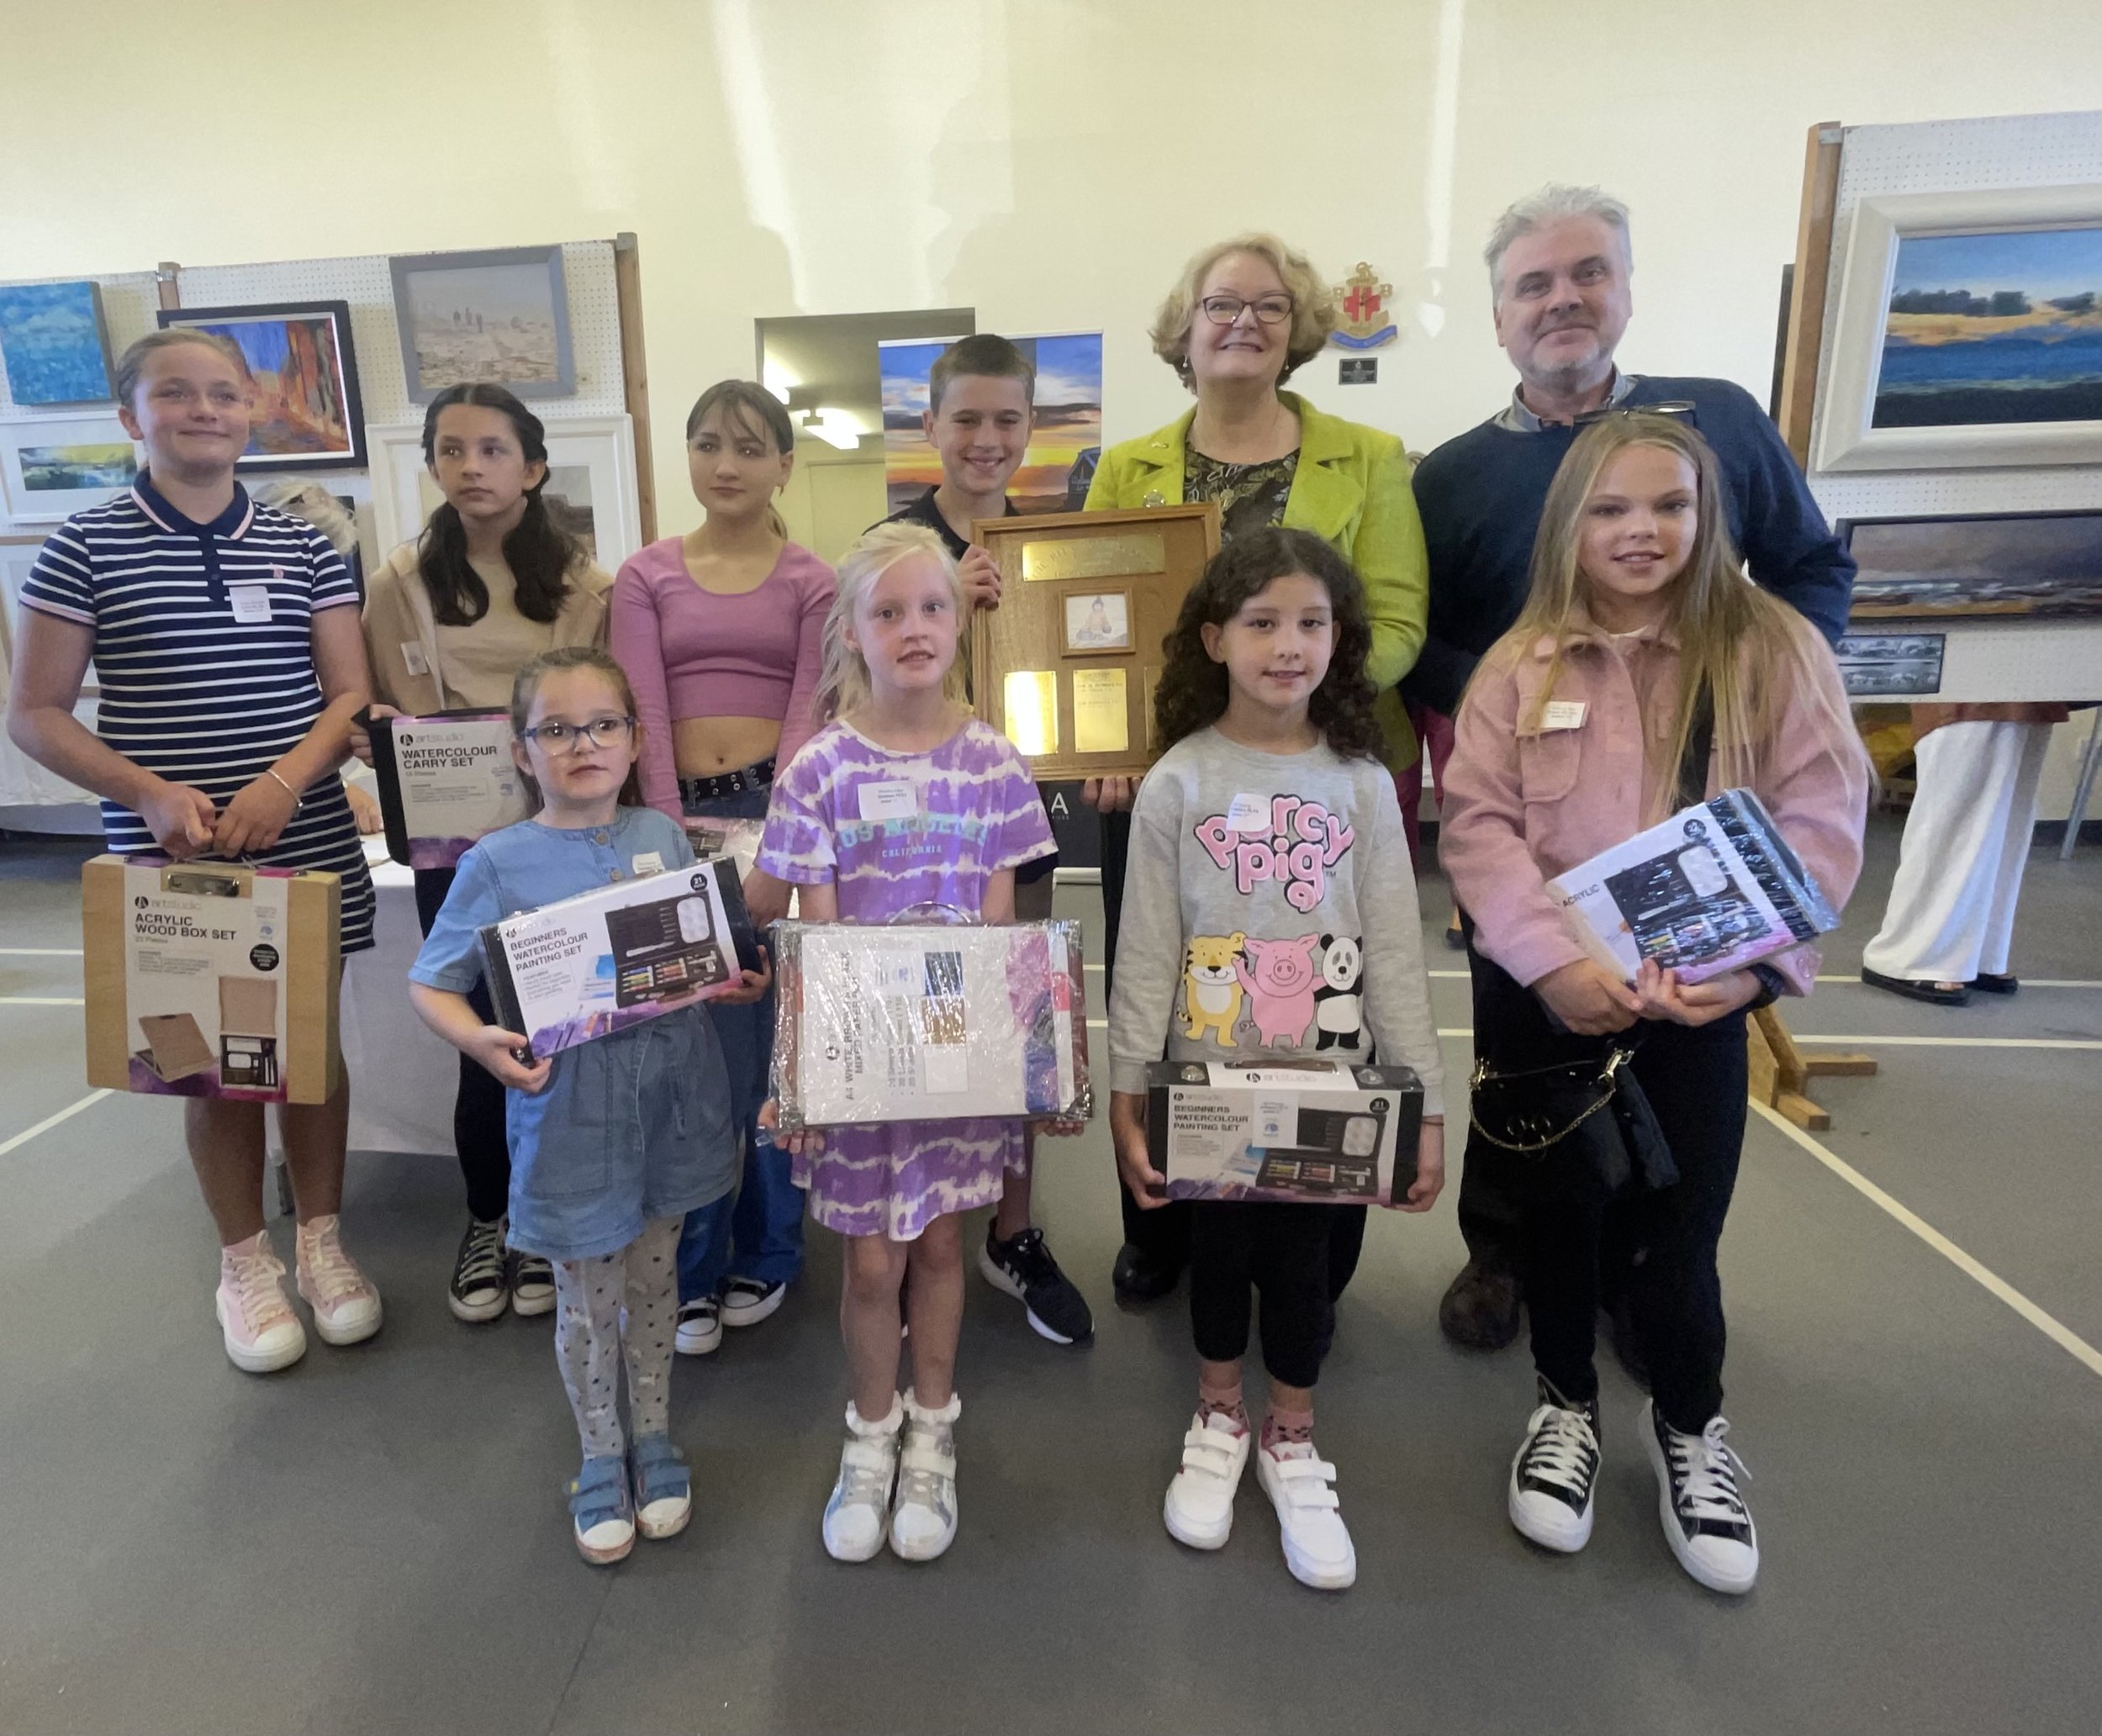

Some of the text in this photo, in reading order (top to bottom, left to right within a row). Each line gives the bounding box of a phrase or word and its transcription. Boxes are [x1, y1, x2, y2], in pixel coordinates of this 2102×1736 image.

[402, 746, 497, 758] WATERCOLOUR
[404, 757, 473, 769] CARRY SET
[1194, 794, 1356, 869] prcy
[882, 845, 943, 858] CALIFORNIA
[1236, 837, 1326, 914] pig
[1562, 884, 1600, 908] ACRYLIC
[135, 913, 193, 926] ACRYLIC
[135, 924, 236, 940] WOOD BOX SET
[510, 927, 568, 952] BEGINNERS
[514, 932, 589, 961] WATERCOLOUR
[515, 944, 582, 973] PAINTING SET
[853, 1040, 863, 1074] MIXED
[1174, 1105, 1230, 1113] BEGINNERS
[1174, 1122, 1218, 1131] PAINTING
[1175, 1114, 1249, 1123] WATERCOLOUR
